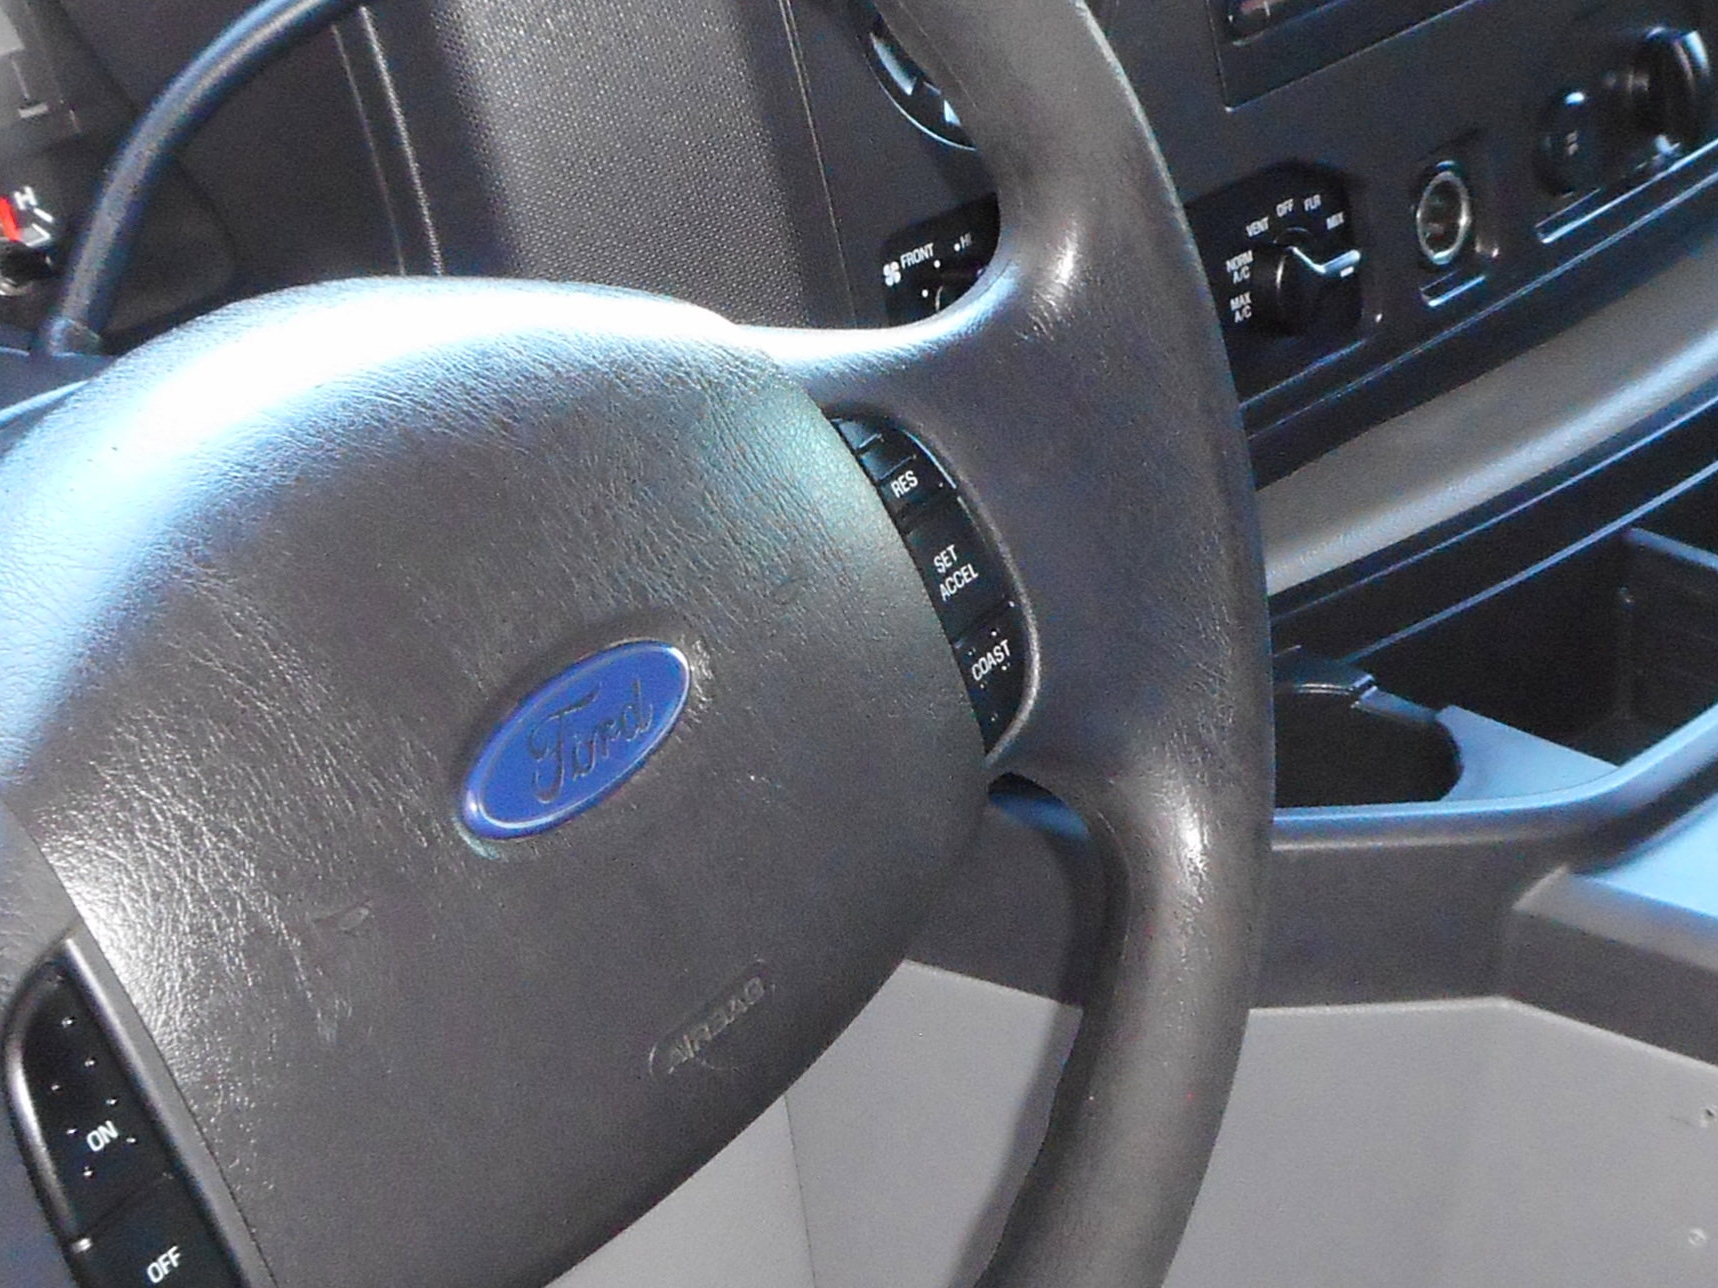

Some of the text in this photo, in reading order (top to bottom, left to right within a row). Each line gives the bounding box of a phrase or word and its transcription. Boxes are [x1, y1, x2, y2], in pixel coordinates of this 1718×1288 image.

[13, 185, 38, 212] H
[1275, 198, 1295, 218] OFF
[1303, 194, 1323, 213] FLR
[1245, 216, 1271, 239] VENT
[899, 241, 935, 270] FRONT
[1225, 249, 1254, 273] NORM
[1232, 264, 1252, 285] A/C
[1229, 290, 1253, 313] MAX
[1233, 305, 1253, 325] A/C
[889, 469, 919, 499] RES
[932, 543, 959, 575] SET
[937, 562, 980, 603] ACCEL
[970, 638, 1013, 683] COAST
[527, 678, 654, 805] Ford
[86, 1119, 119, 1153] ON
[145, 1244, 183, 1286] OFF
